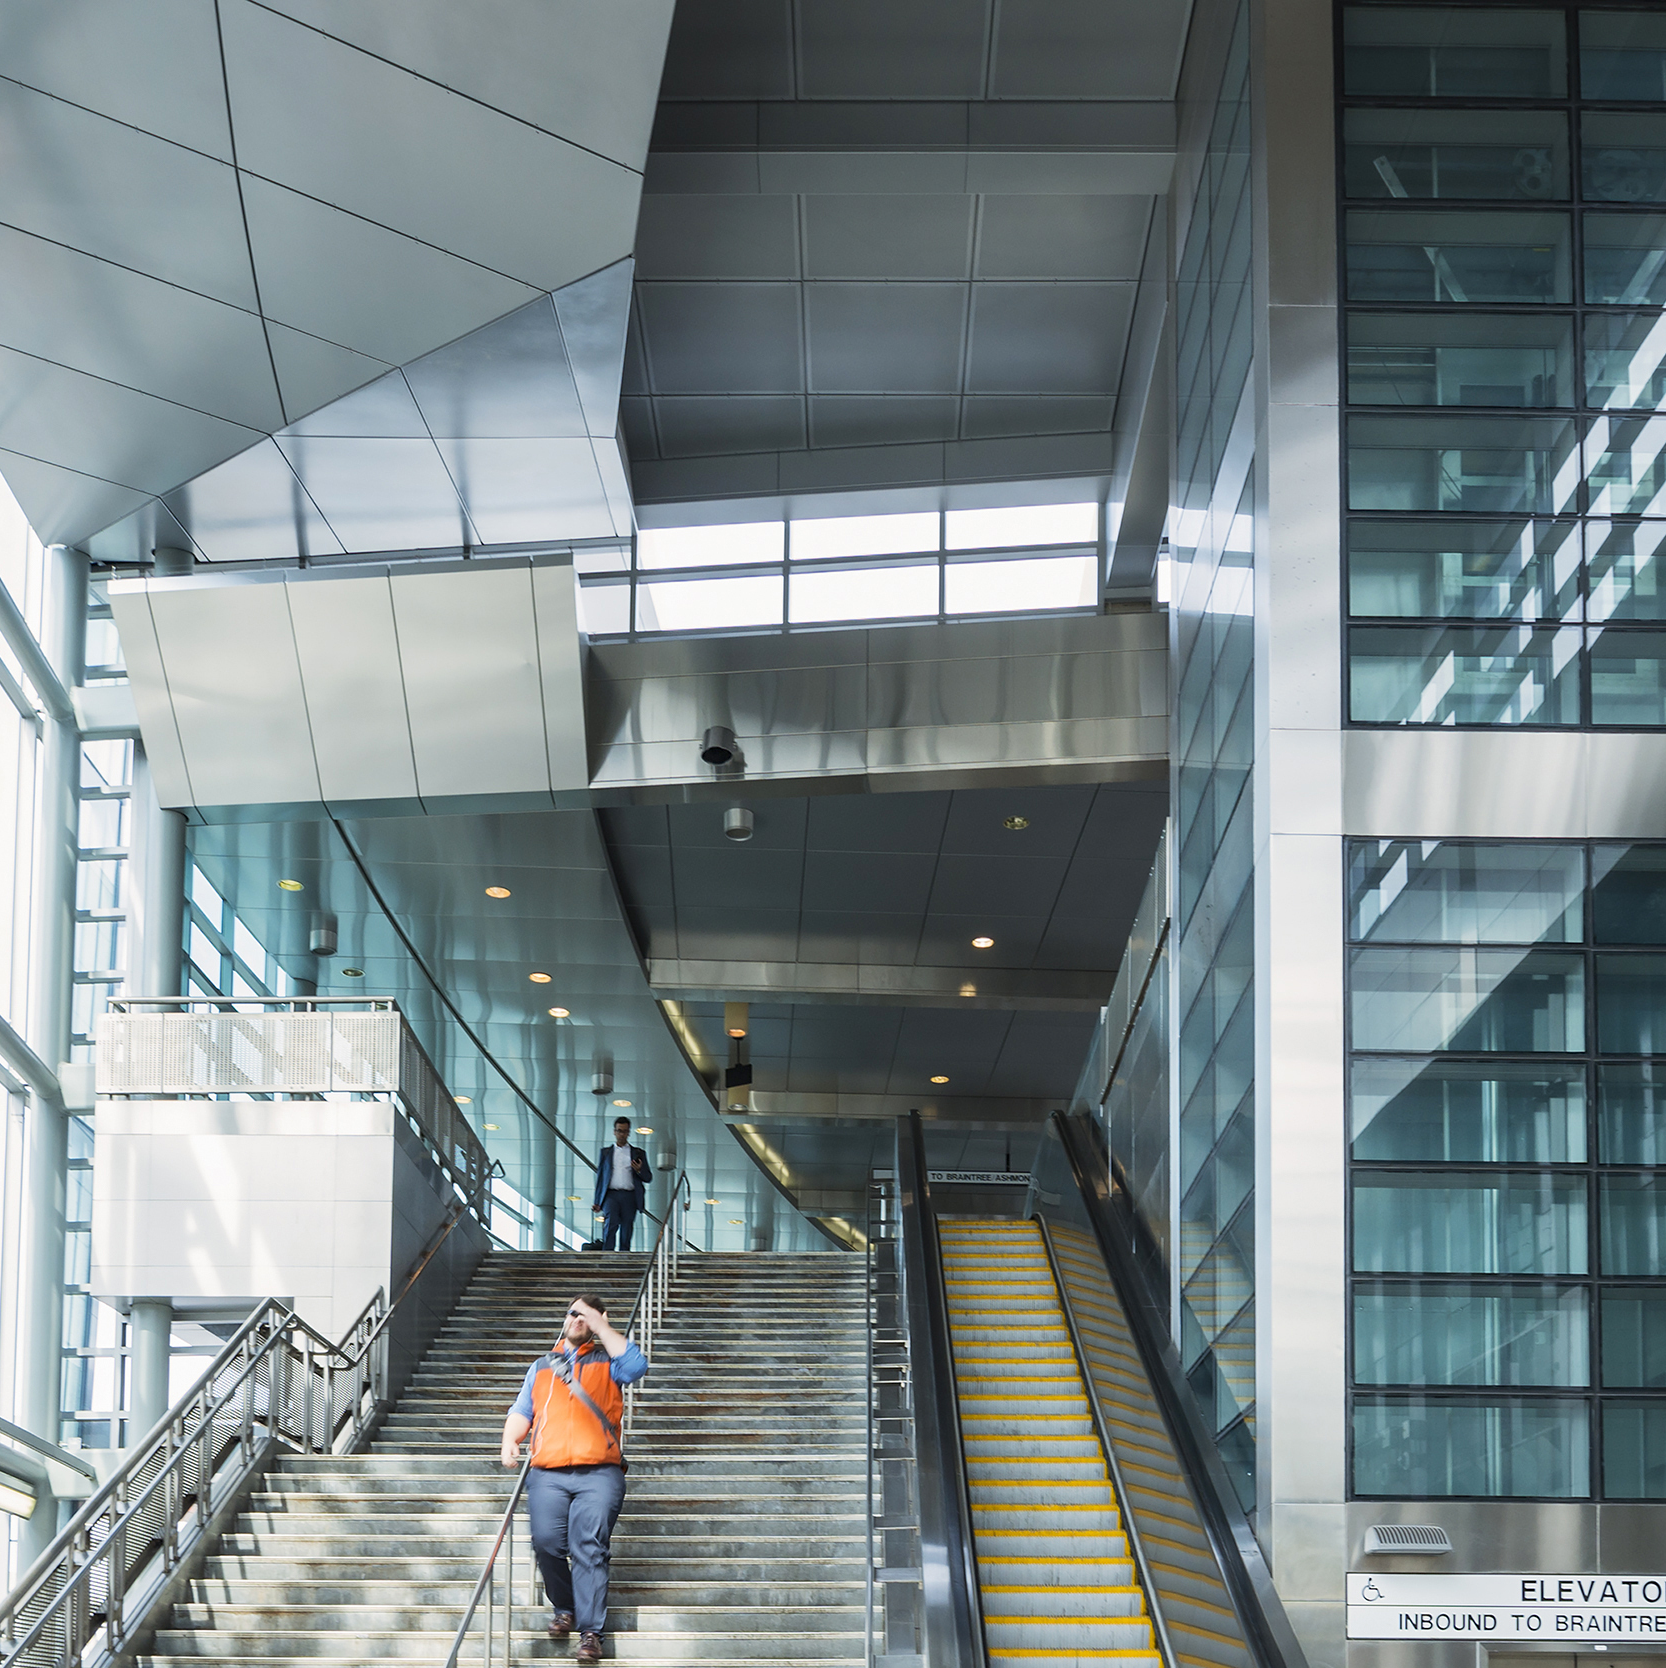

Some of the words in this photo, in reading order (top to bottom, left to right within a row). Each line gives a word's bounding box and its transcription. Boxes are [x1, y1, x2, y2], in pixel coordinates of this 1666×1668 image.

[931, 1172, 943, 1181] TO
[946, 1173, 1031, 1182] BRAINTREE/ASHMON
[1399, 1613, 1497, 1631] INBOUND
[1511, 1614, 1542, 1631] TO
